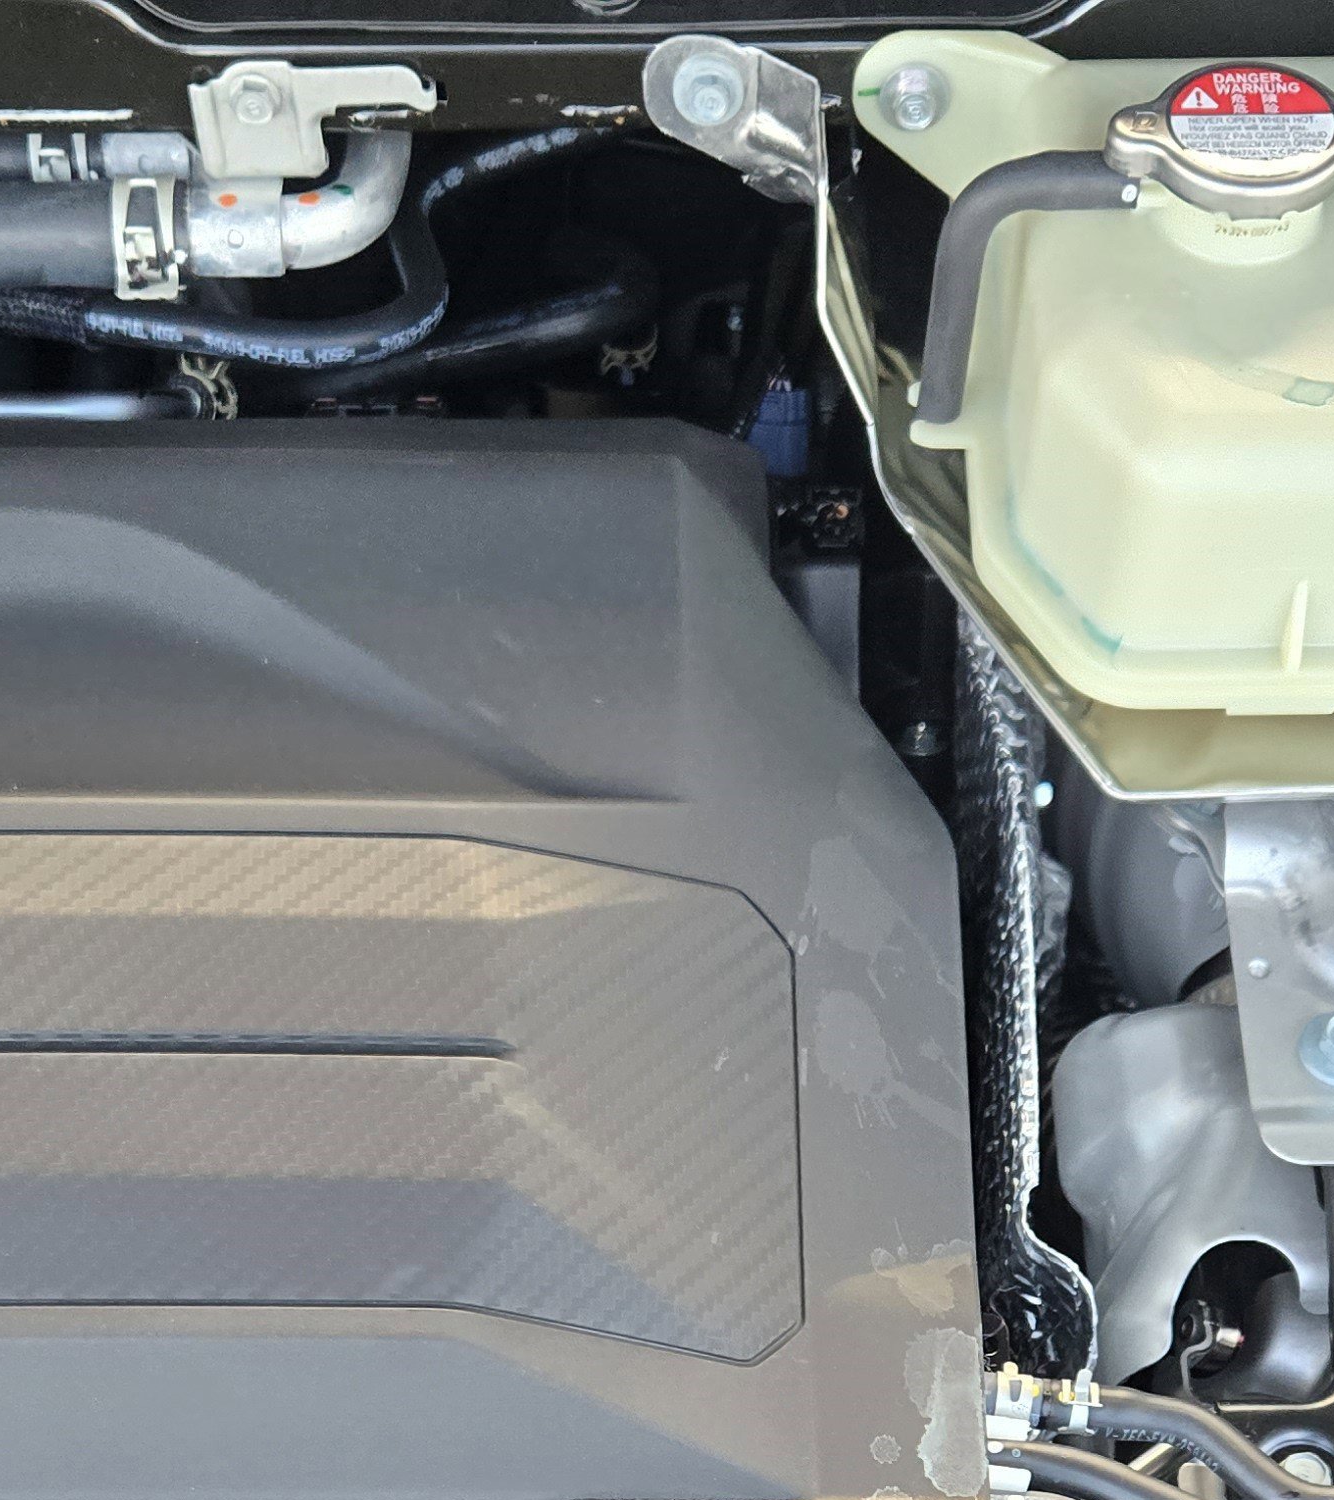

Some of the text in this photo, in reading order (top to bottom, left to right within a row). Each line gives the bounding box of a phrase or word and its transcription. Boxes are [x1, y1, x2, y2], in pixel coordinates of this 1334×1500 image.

[1213, 72, 1282, 84] DANGER
[1216, 82, 1301, 95] WARNUNG
[1226, 116, 1257, 124] OPEN
[1258, 116, 1290, 124] WHEN
[1233, 132, 1253, 140] PAS
[1255, 132, 1291, 140] QUAND
[1263, 140, 1292, 148] MOTOR
